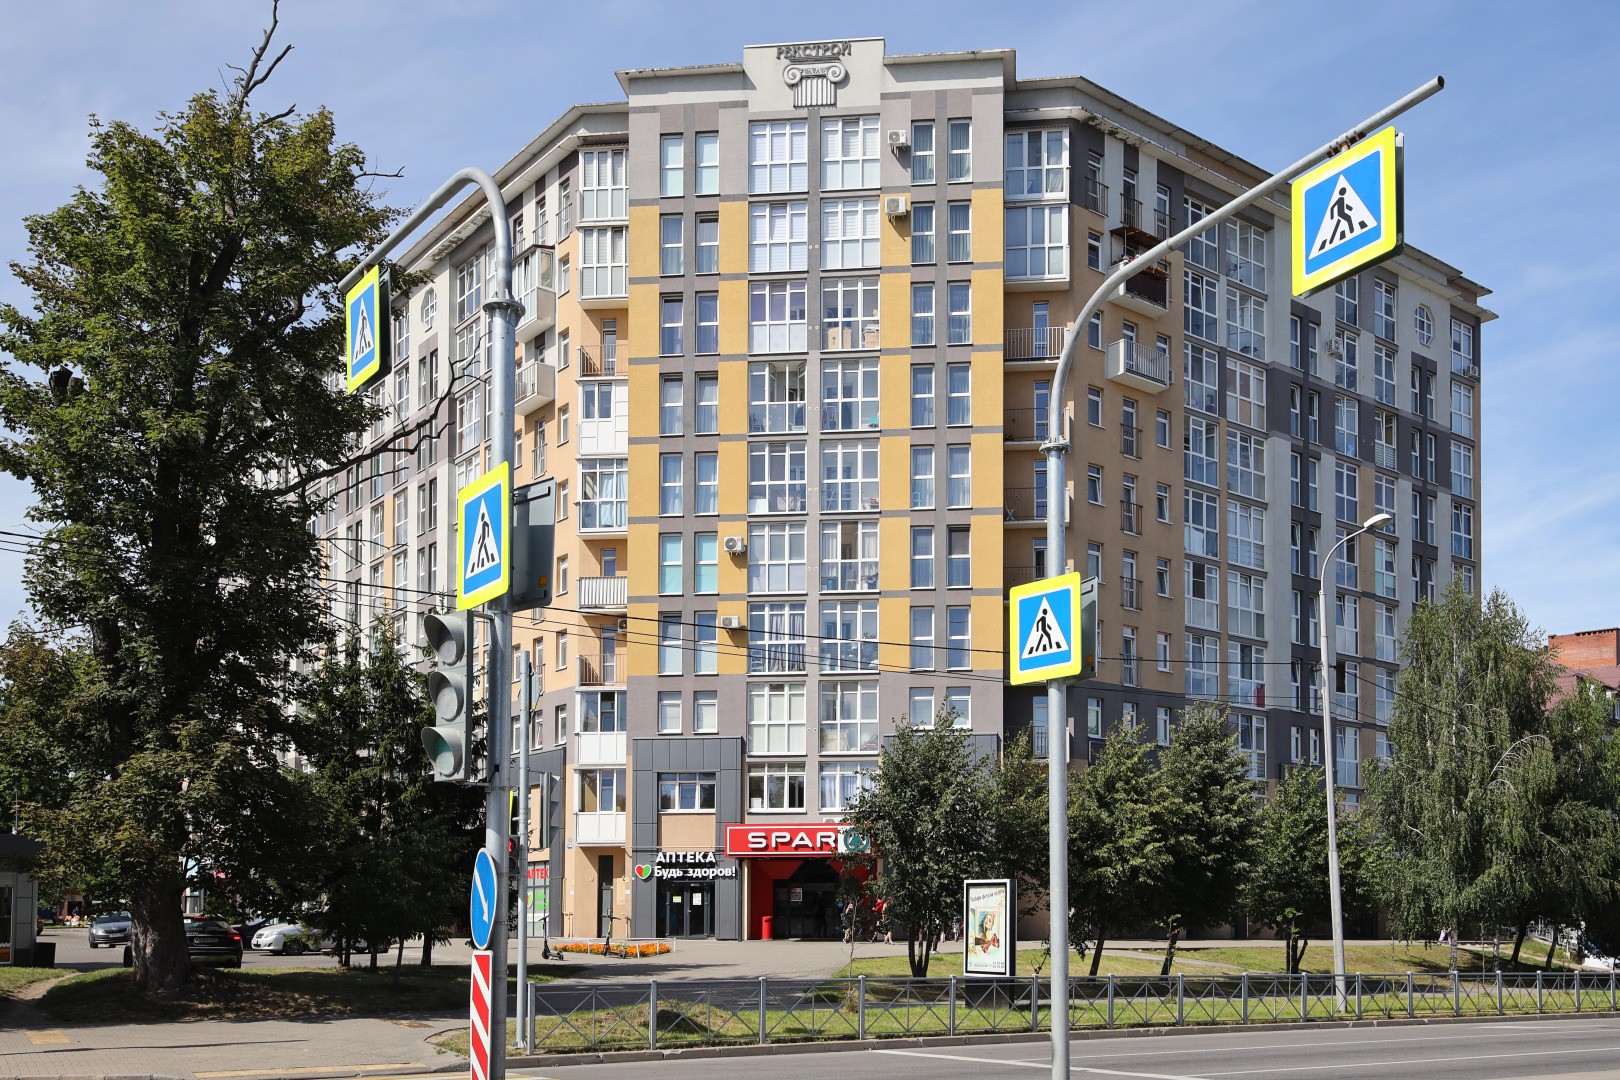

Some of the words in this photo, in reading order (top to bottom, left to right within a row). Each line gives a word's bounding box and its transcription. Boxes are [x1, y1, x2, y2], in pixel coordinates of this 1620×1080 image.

[776, 41, 852, 60] РЕКСТРОЙ
[747, 831, 836, 849] SPAR
[655, 851, 716, 863] АПТЕКА
[654, 866, 683, 879] Будь
[686, 866, 736, 879] здоров!
